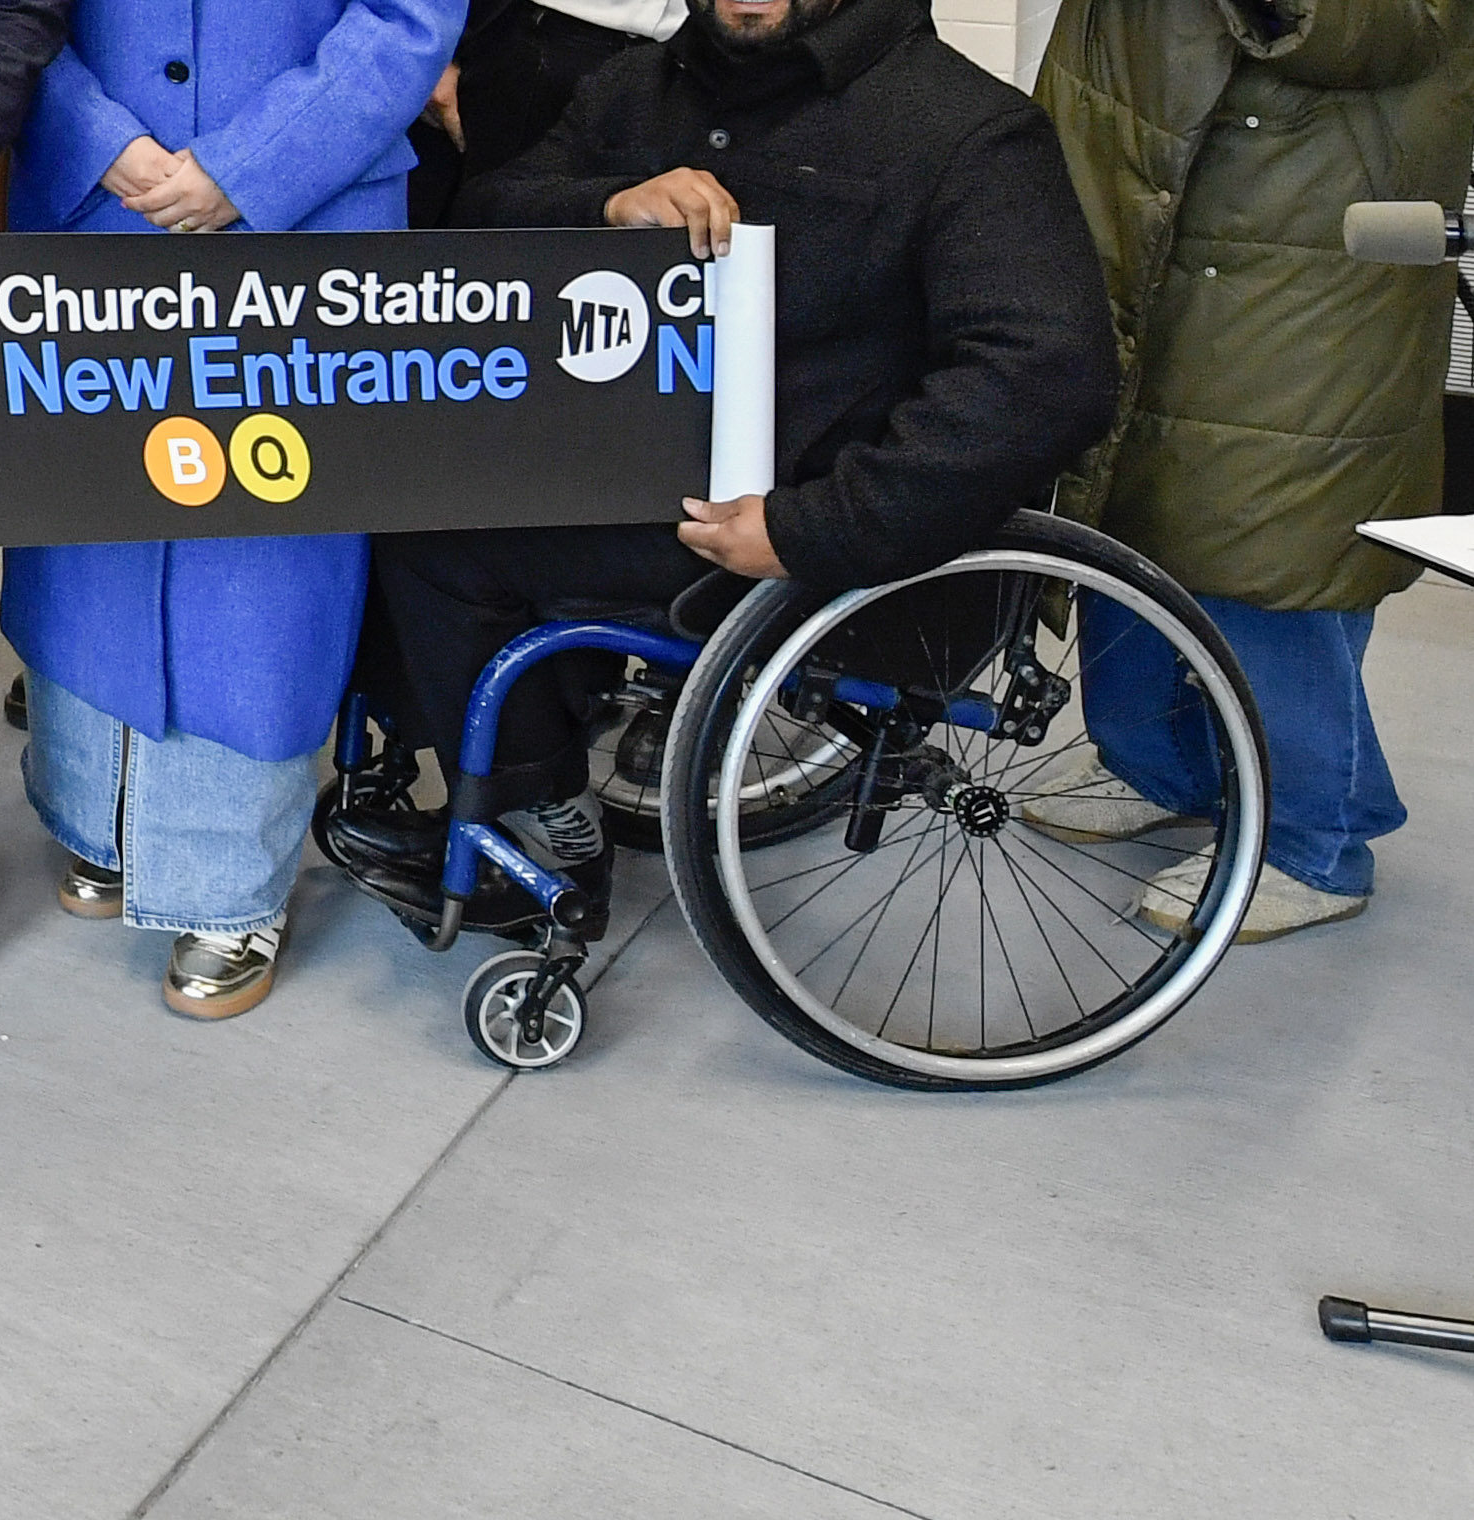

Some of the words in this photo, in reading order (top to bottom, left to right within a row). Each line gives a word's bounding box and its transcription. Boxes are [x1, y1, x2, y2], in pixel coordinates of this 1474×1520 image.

[227, 271, 306, 328] Av
[316, 267, 531, 326] Station
[2, 340, 174, 416] New
[188, 335, 529, 409] Entrance
[167, 437, 207, 485] B
[250, 434, 297, 482] Q
